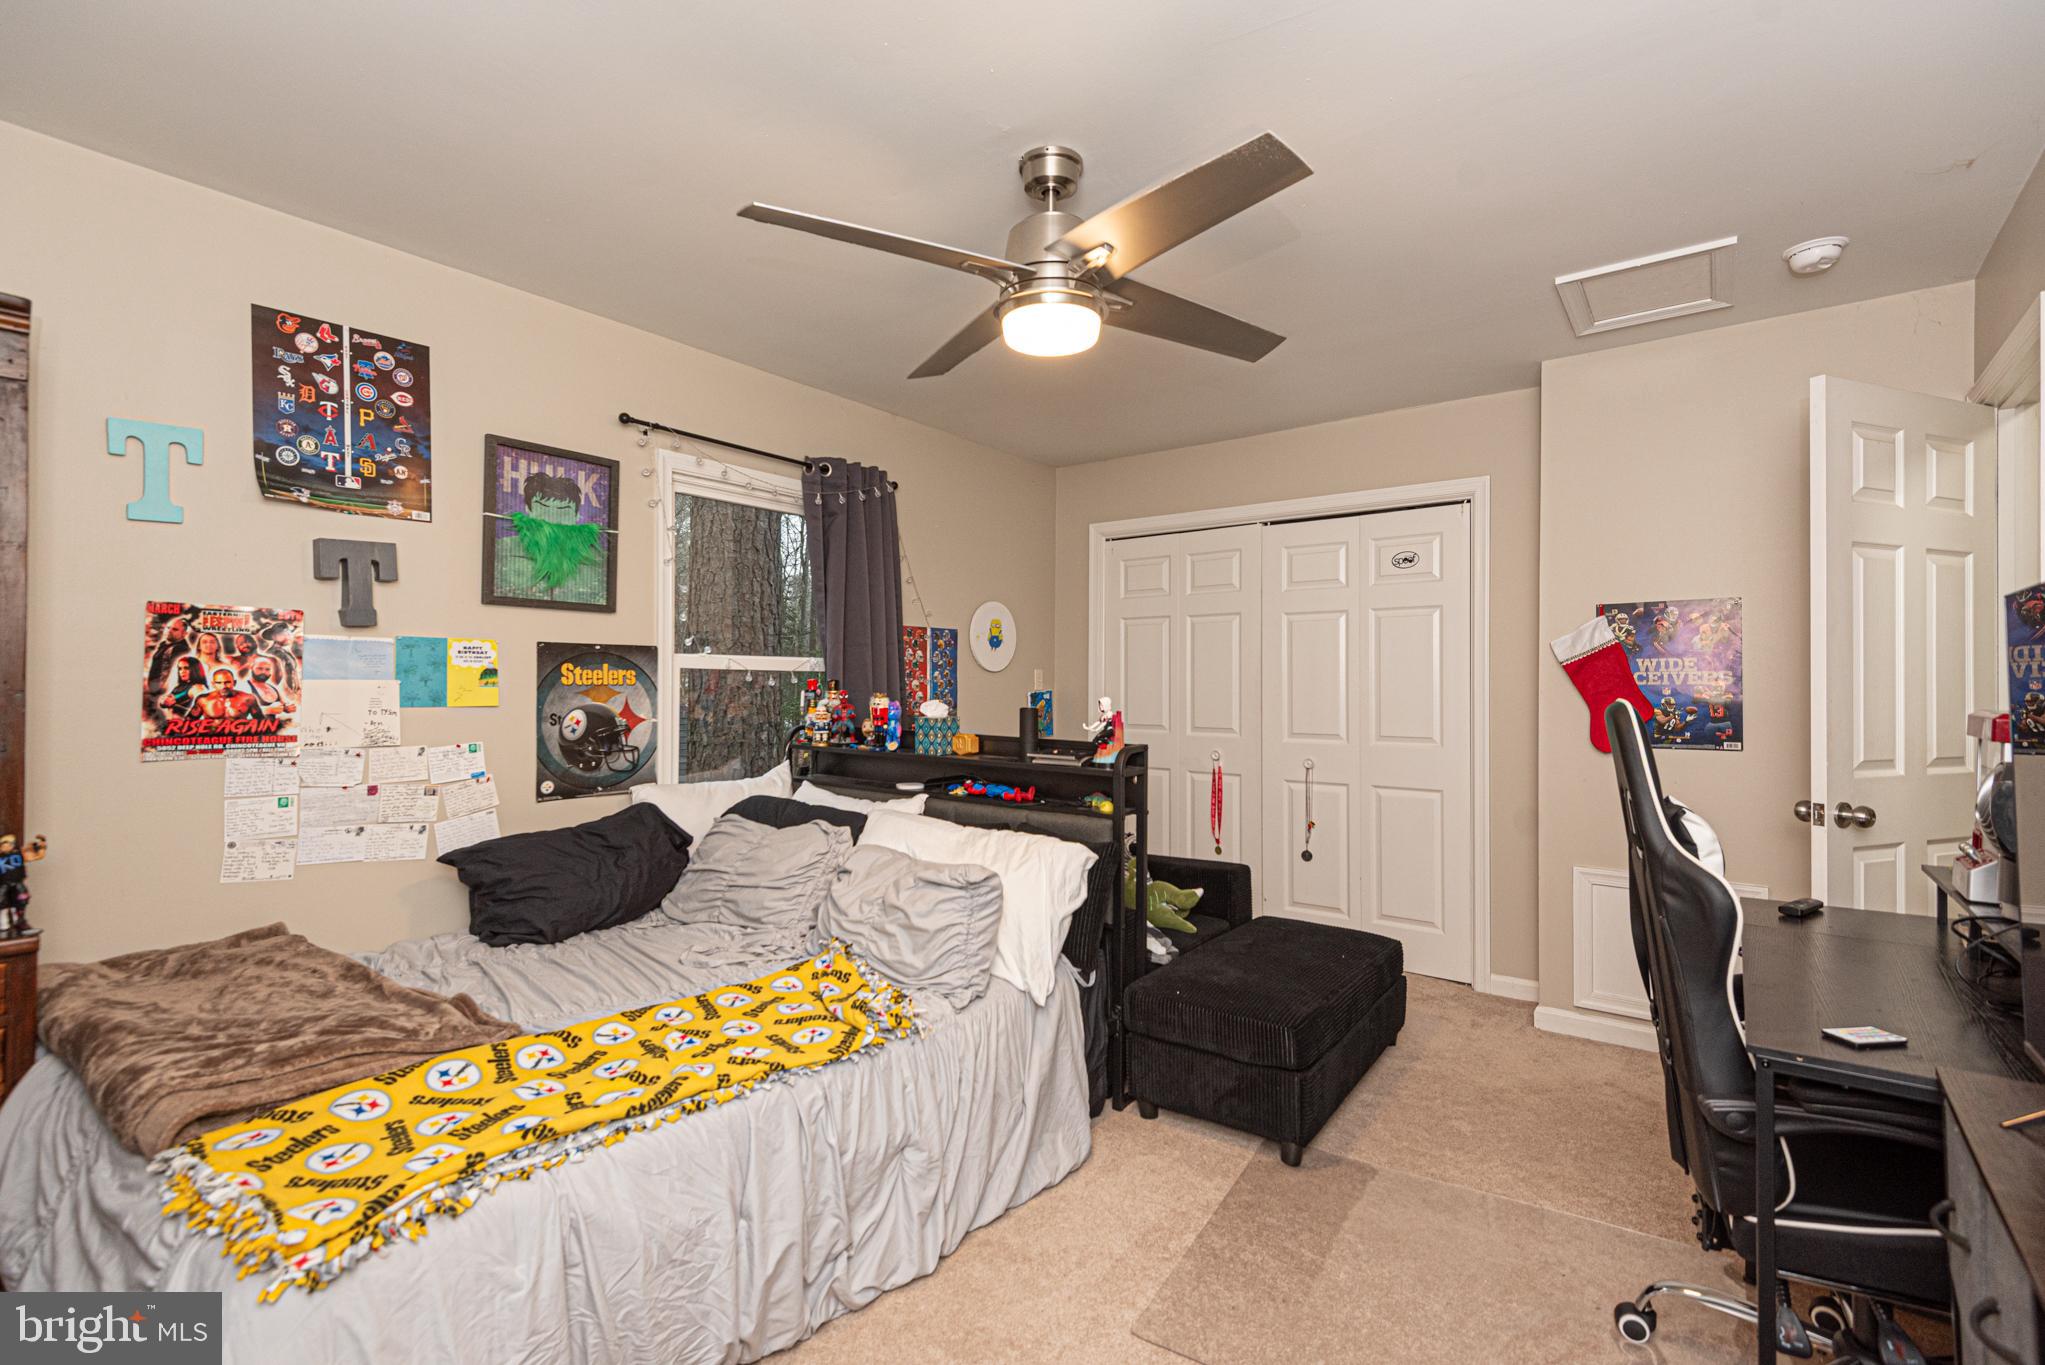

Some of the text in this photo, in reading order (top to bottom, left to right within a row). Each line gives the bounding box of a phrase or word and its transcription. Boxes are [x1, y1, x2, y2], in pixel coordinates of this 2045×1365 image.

[359, 408, 375, 427] P
[107, 417, 204, 524] T
[503, 456, 601, 508] HK
[312, 536, 398, 629] T
[146, 602, 181, 614] MARCH
[560, 662, 637, 686] Steelers
[1636, 658, 1698, 673] WIDE
[1633, 670, 1734, 686] CEIVERS
[165, 718, 281, 735] RISE AGAIN
[143, 736, 233, 747] CHINCOTEAGUE
[236, 736, 259, 744] FIRE
[261, 735, 297, 743] HOUSE
[487, 1042, 518, 1084] Steelers
[447, 1104, 526, 1141] Steelers
[245, 1124, 341, 1173] Steelers
[380, 1119, 415, 1156] Steelers
[284, 1174, 388, 1193] Steelers
